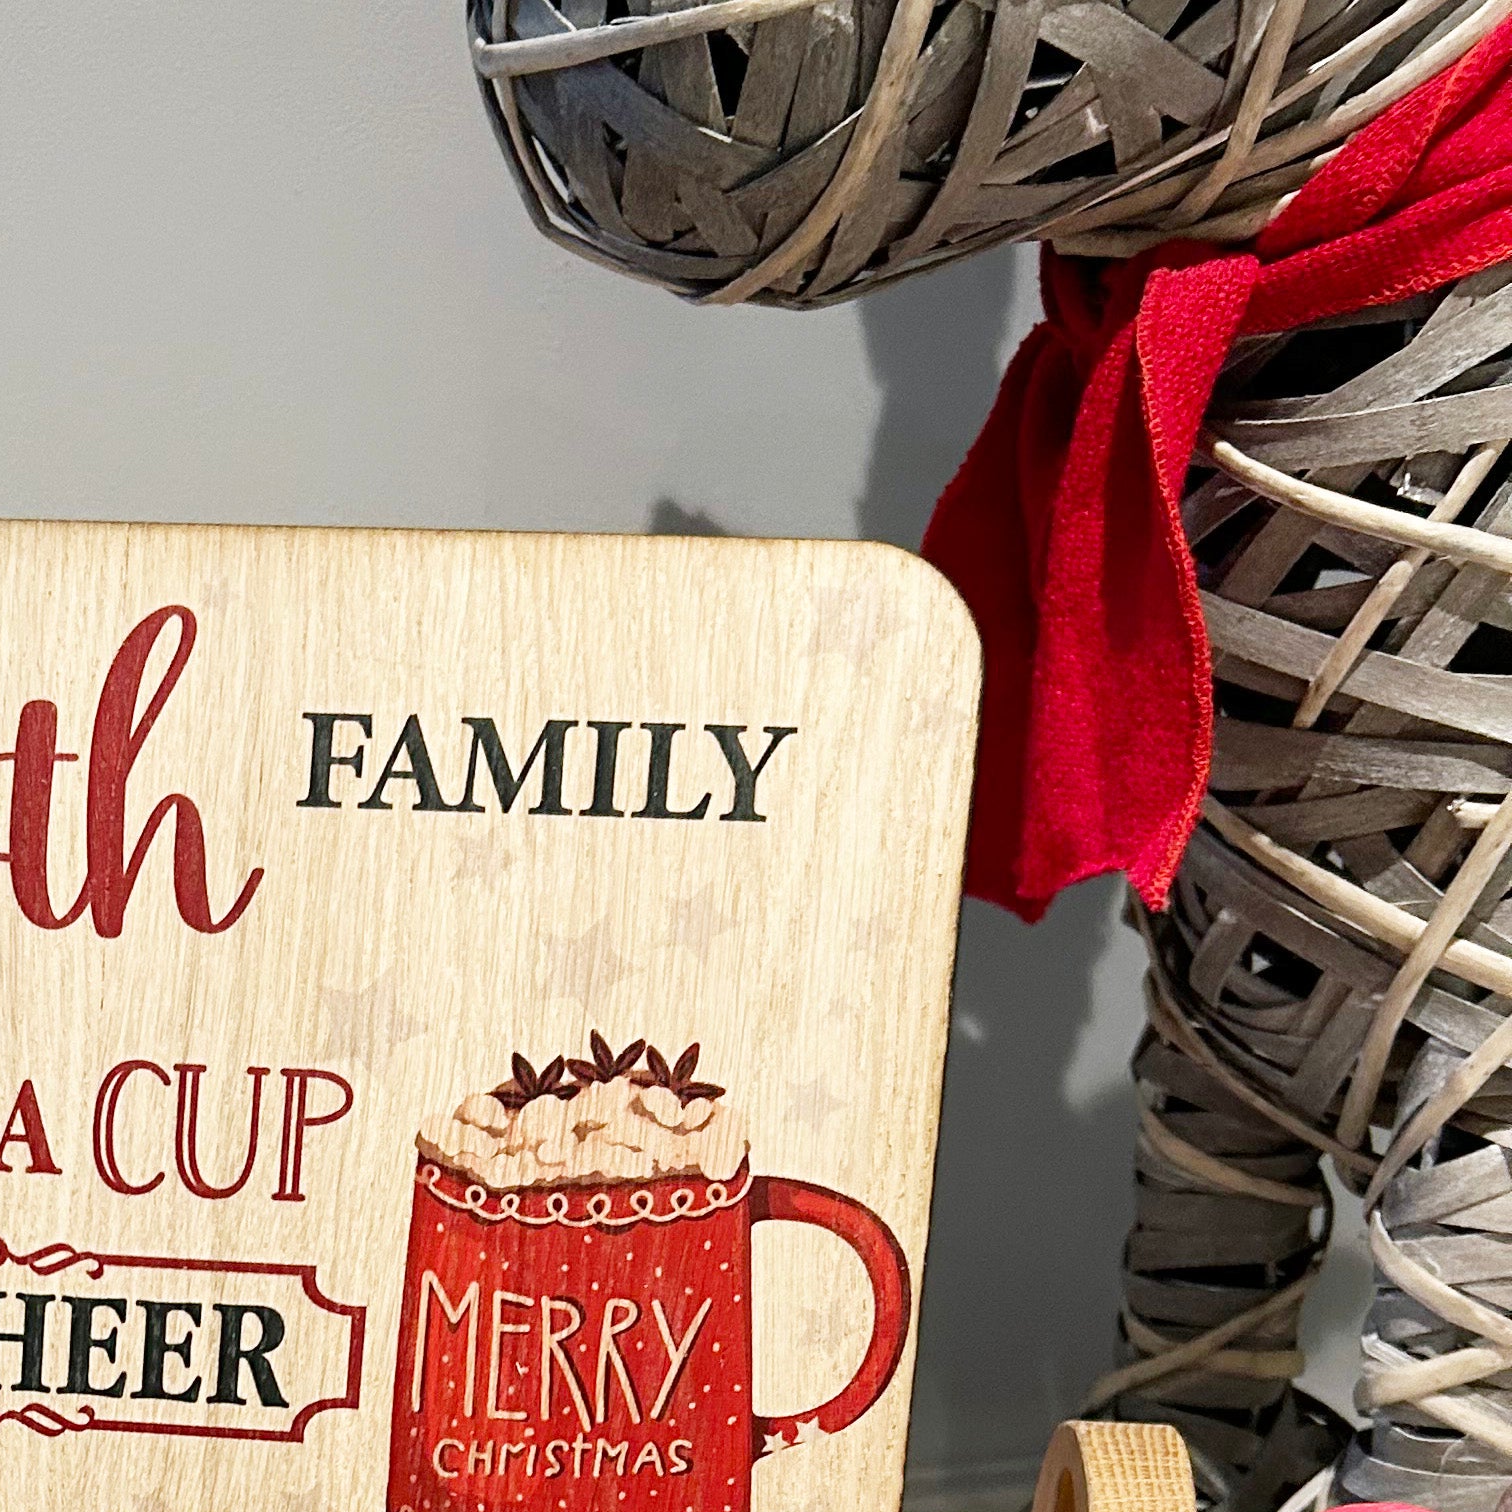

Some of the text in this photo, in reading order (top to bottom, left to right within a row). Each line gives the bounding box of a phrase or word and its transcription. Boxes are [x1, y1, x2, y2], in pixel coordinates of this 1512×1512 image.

[296, 711, 798, 822] FAMILY
[92, 1059, 355, 1201] CUP
[413, 1269, 713, 1432] MERRY
